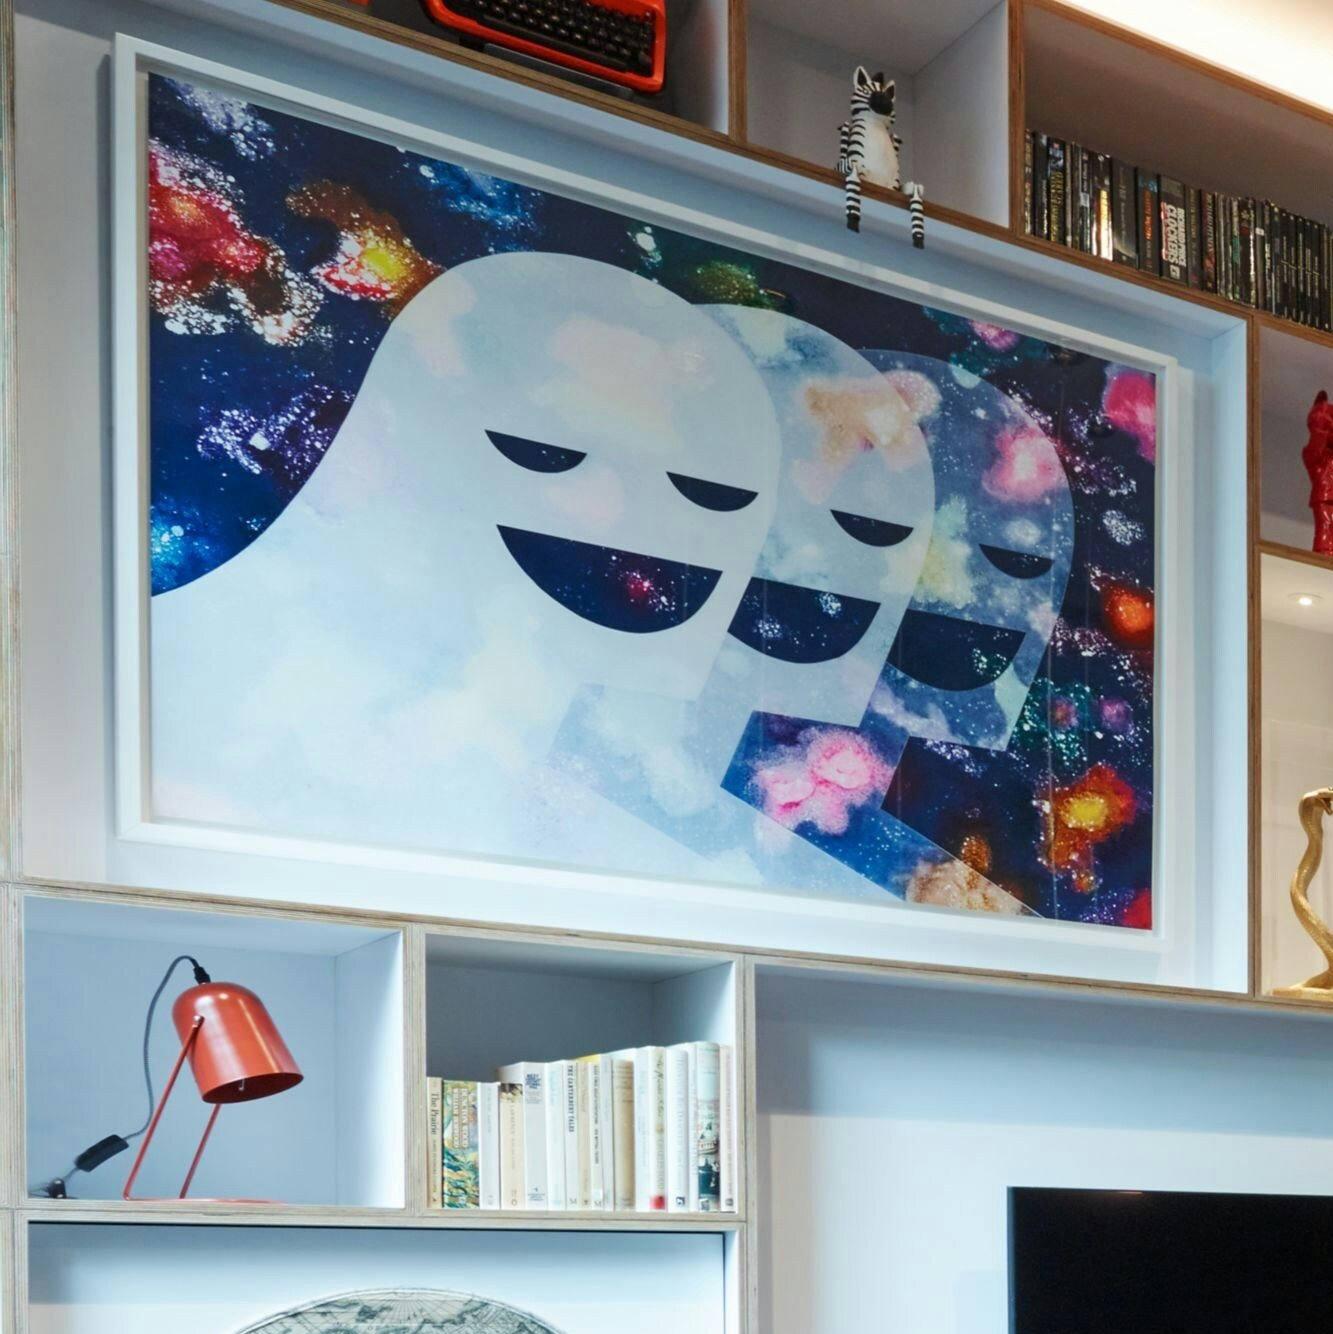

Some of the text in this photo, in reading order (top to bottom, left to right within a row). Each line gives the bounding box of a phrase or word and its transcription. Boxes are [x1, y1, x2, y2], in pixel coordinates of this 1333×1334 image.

[1166, 203, 1177, 264] CLOCKERS
[430, 1092, 439, 1134] The Prairie
